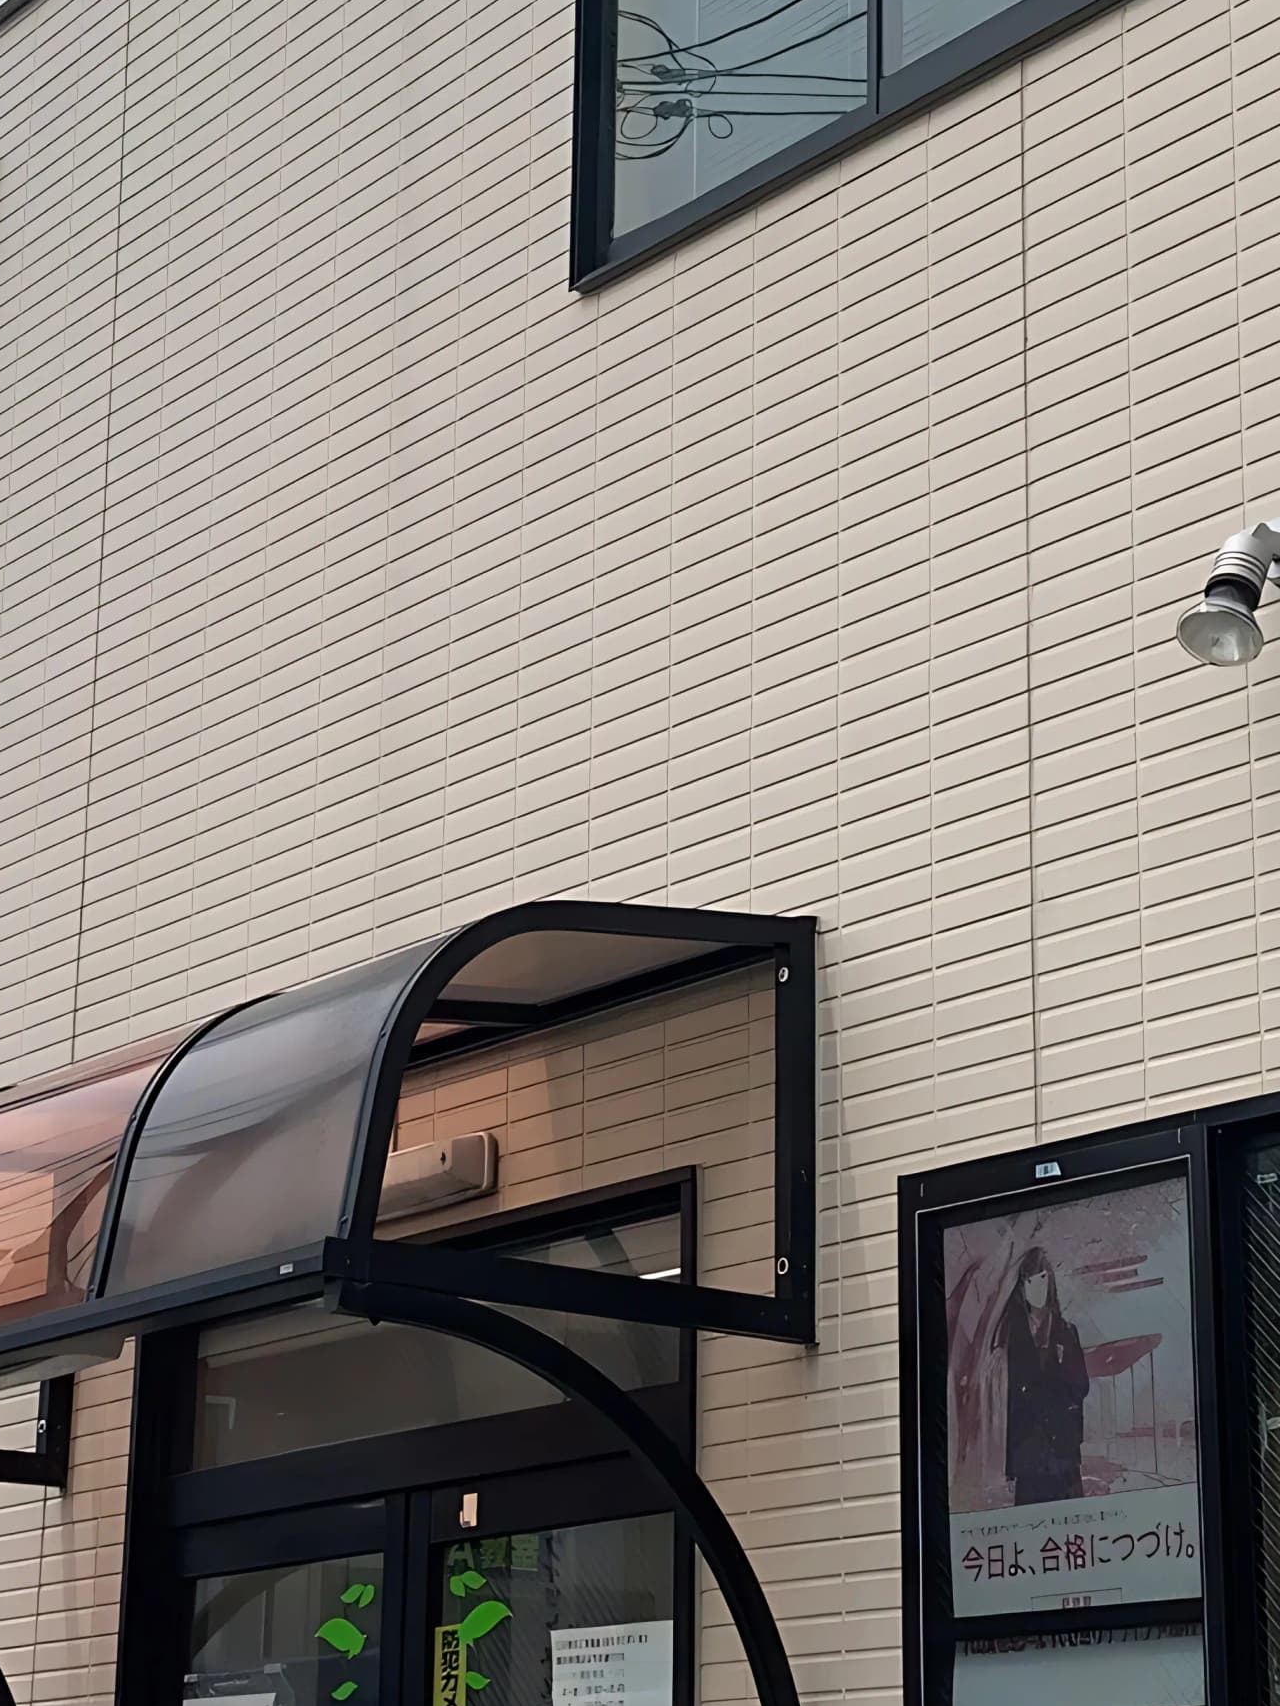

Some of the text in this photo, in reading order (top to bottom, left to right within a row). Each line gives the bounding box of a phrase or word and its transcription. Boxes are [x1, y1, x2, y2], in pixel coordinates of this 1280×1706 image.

[962, 1521, 1196, 1581] 今日よ、合格につづけ。
